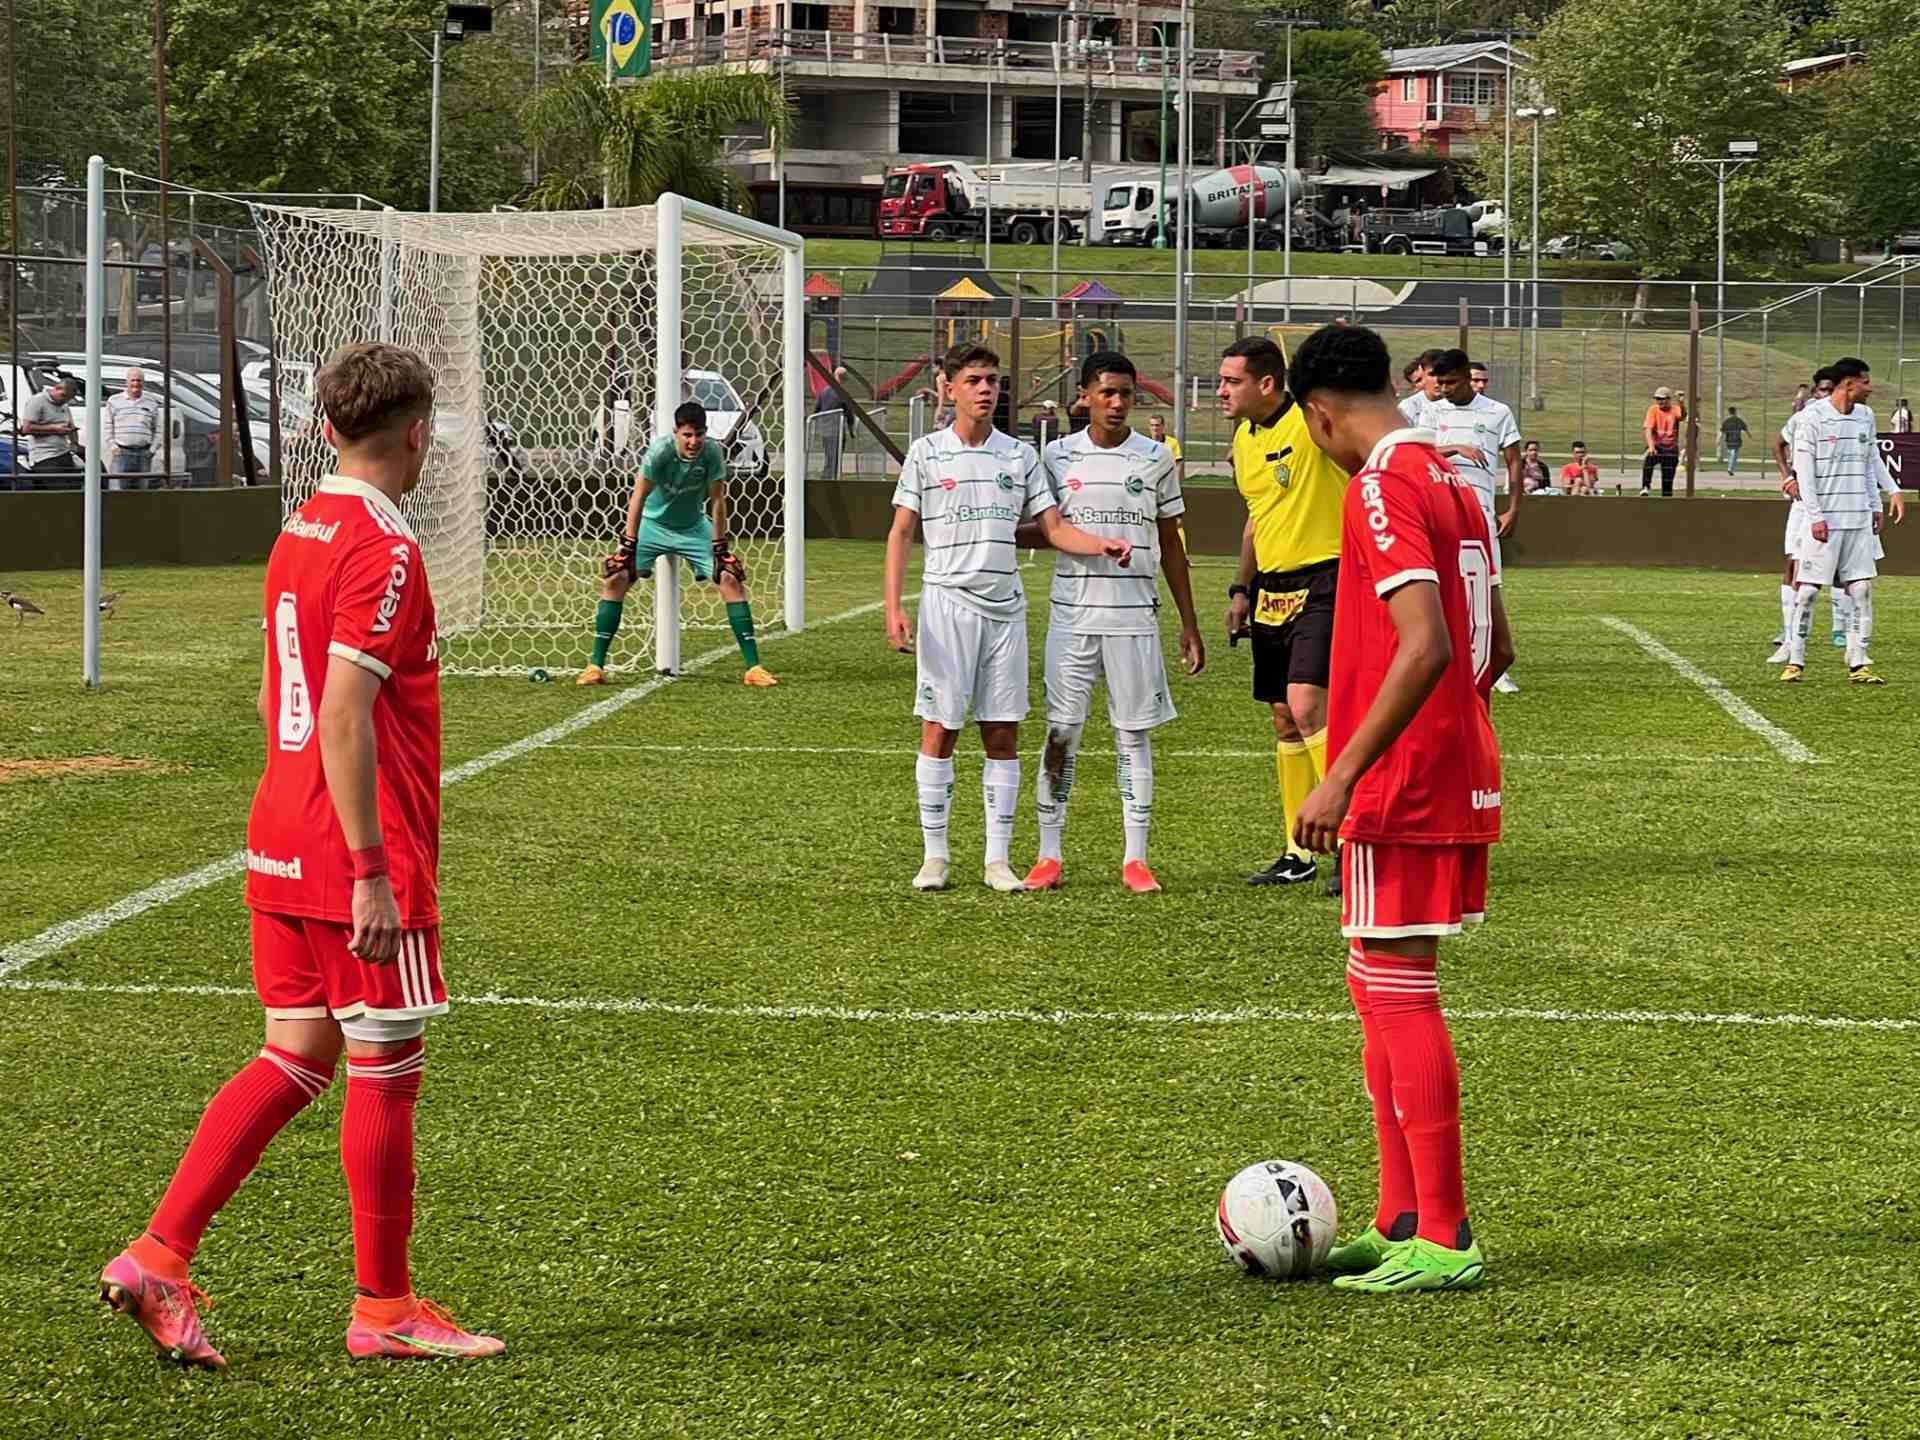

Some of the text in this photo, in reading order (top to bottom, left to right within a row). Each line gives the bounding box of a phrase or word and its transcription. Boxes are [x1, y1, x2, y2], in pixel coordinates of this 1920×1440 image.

[1082, 506, 1144, 526] Banrisul
[1361, 472, 1389, 532] vero
[373, 563, 408, 633] vero
[275, 591, 314, 751] 8
